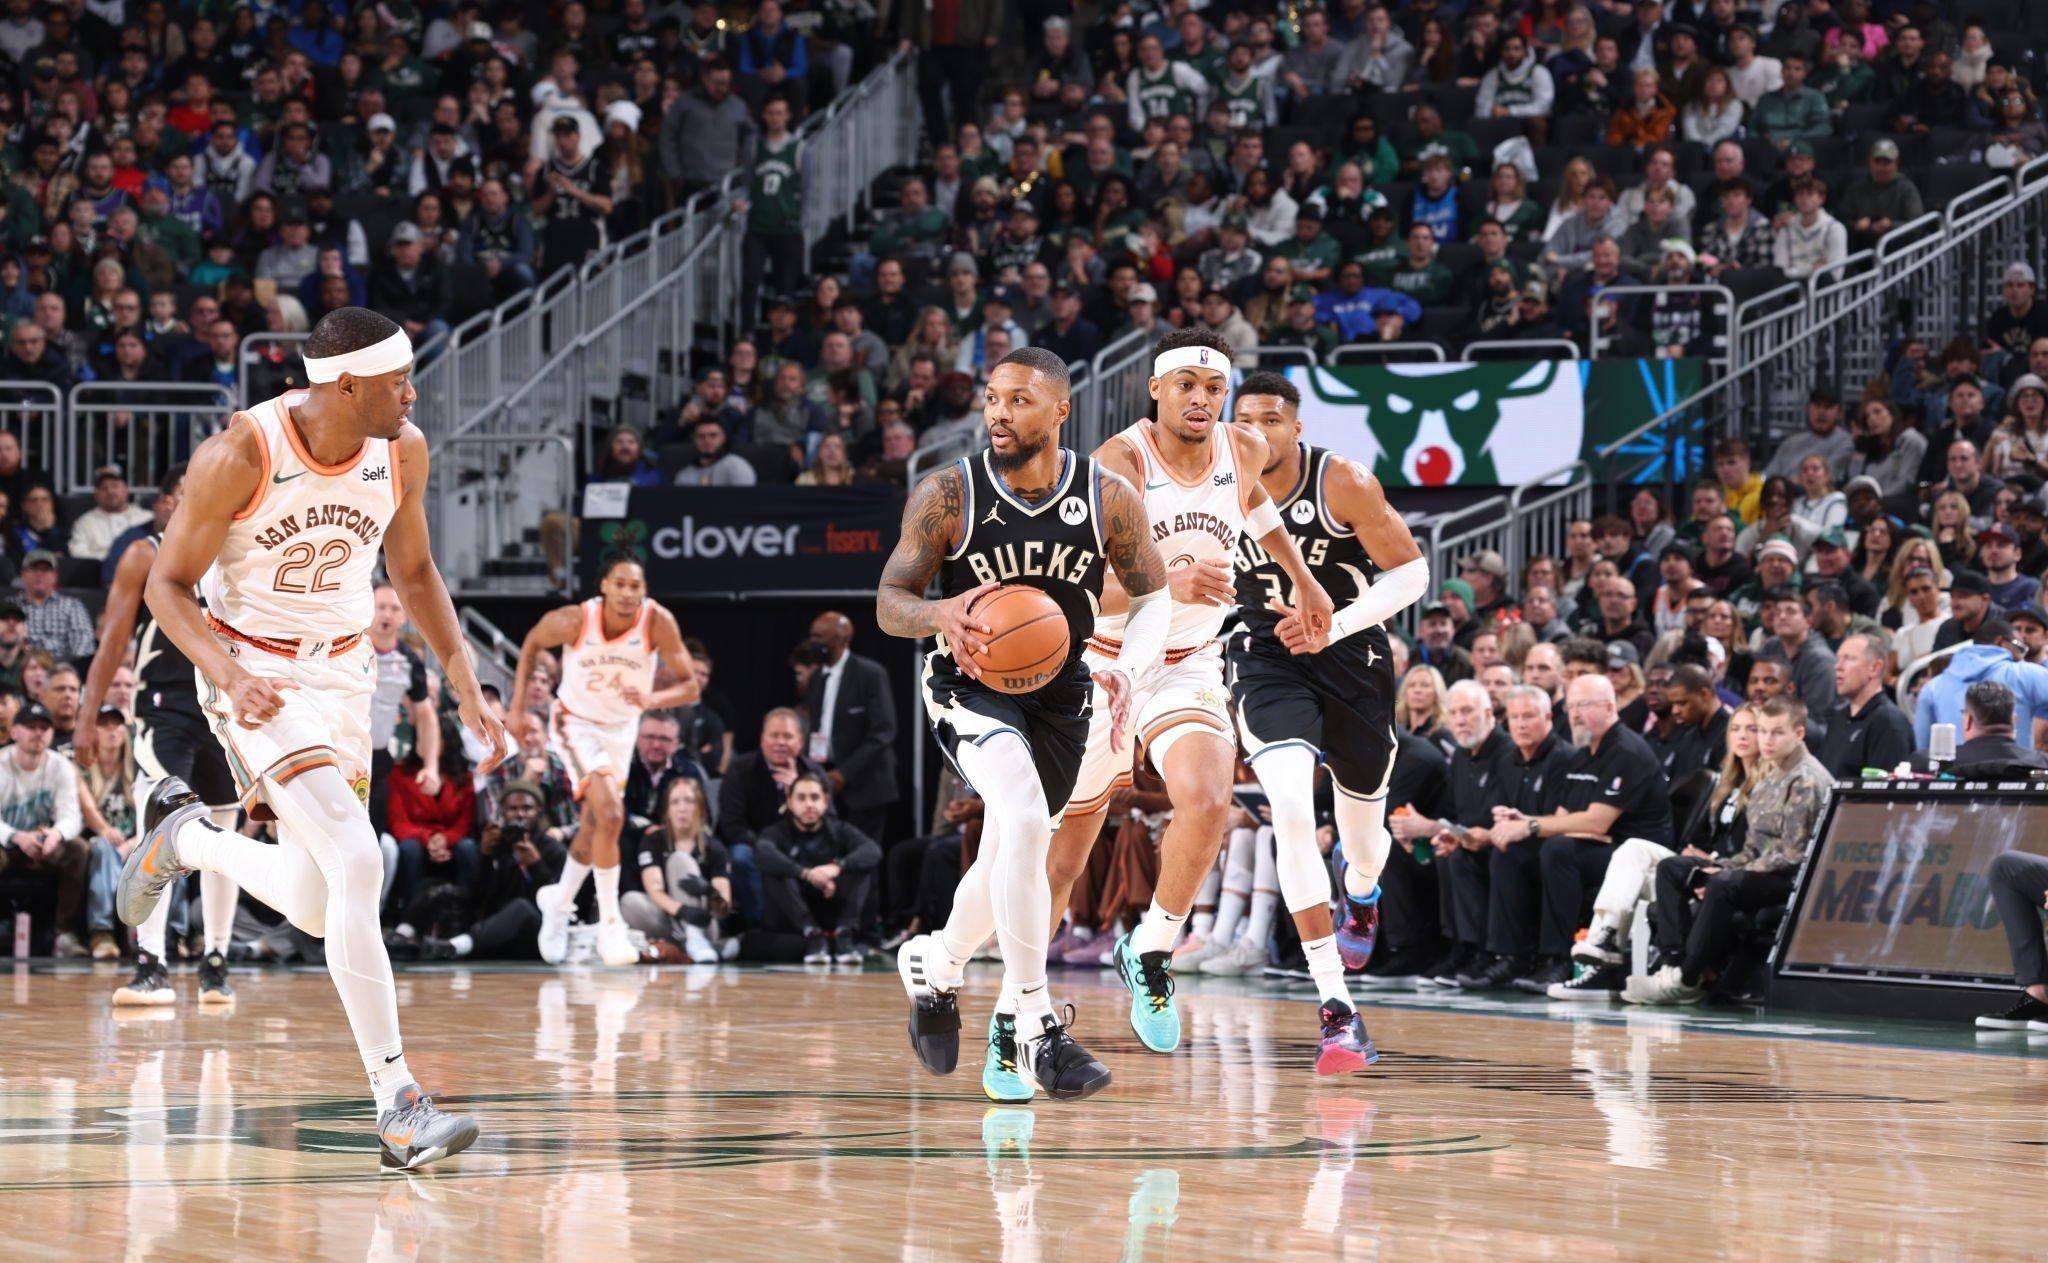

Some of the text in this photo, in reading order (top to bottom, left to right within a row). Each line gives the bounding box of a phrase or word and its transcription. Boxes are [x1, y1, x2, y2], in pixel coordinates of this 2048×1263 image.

[362, 466, 389, 482] Self.
[1213, 472, 1236, 487] Self.
[254, 504, 380, 551] SAN ANTONI
[652, 515, 800, 559] clover
[1174, 512, 1236, 551] ANTONIO
[273, 538, 352, 594] 22
[967, 541, 1095, 585] BUCKS
[1234, 534, 1330, 572] BUKS
[586, 671, 623, 692] 24
